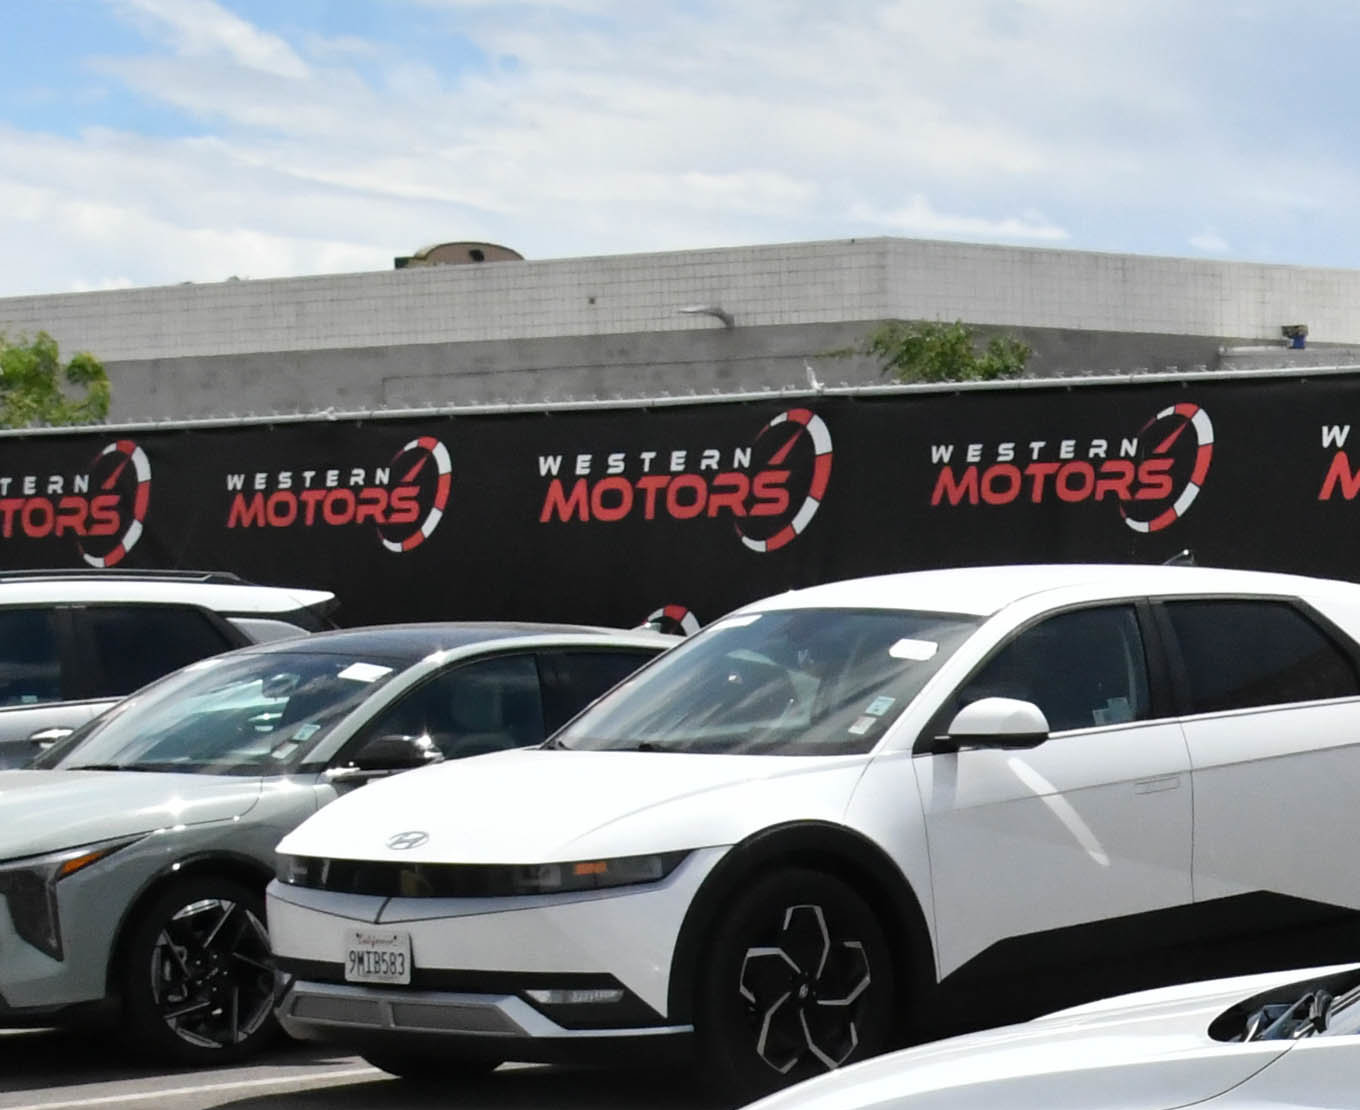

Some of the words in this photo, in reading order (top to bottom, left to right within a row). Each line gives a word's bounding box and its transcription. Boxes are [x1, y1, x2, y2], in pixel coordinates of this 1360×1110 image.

[538, 447, 752, 477] WESTERN
[931, 437, 1138, 462] WESTERN
[227, 467, 391, 491] WESTERN
[931, 457, 1175, 506] MOTORS
[227, 485, 421, 529] MOTORS
[539, 471, 791, 523] MOTORS
[348, 949, 405, 976] 9MIB583
